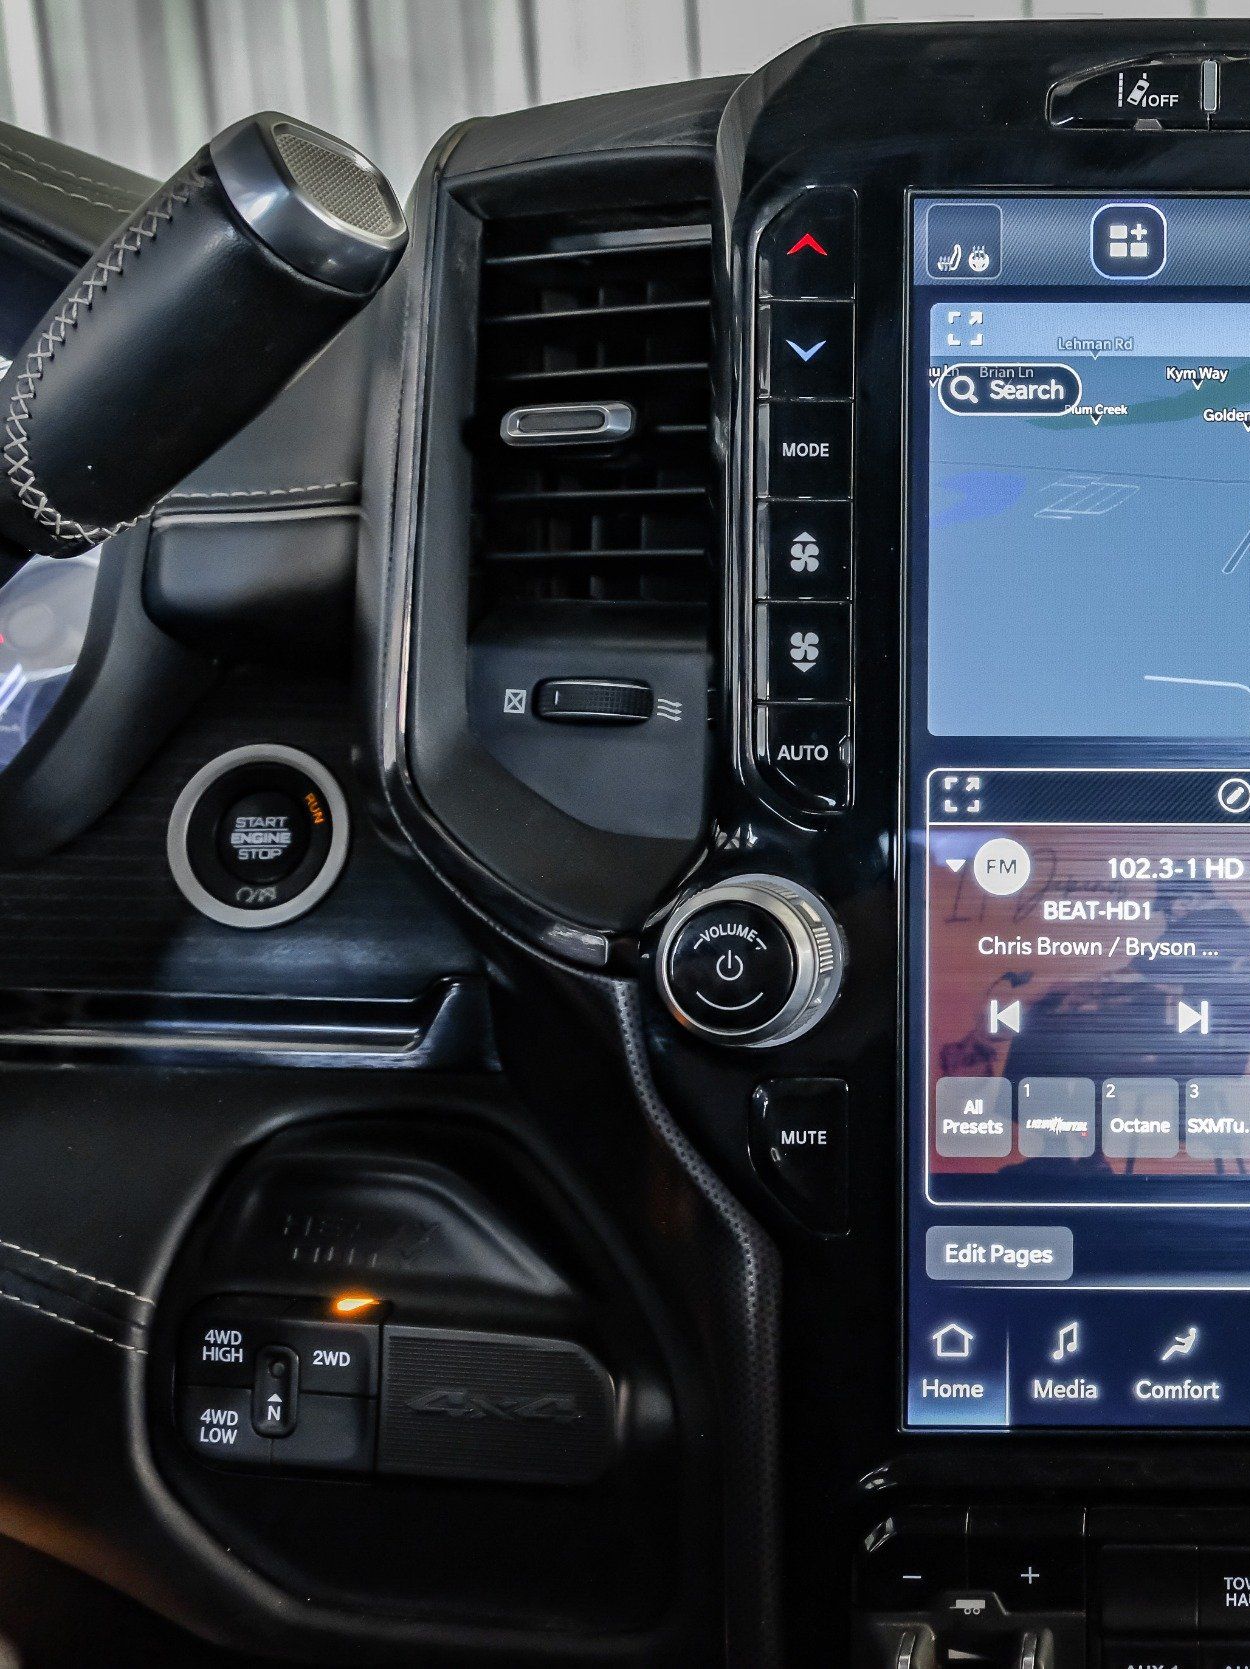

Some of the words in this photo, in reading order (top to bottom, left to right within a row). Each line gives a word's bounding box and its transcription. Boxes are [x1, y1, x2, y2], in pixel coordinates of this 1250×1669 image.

[1148, 94, 1179, 107] OFF
[1057, 336, 1111, 351] Lehman
[1114, 336, 1133, 351] Rd
[979, 367, 1015, 379] Brian
[1018, 367, 1034, 379] Ln
[1166, 366, 1197, 384] Kym
[1198, 366, 1229, 383] Way
[989, 378, 1065, 401] Search
[1094, 403, 1129, 415] Creek
[782, 442, 830, 457] MODE
[777, 744, 829, 761] AUTO
[304, 792, 325, 825] RUN
[235, 816, 288, 829] START
[230, 832, 291, 844] ENGINE
[237, 848, 283, 861] STOP
[985, 858, 1018, 875] FM
[1107, 857, 1197, 880] 102.3-1
[1205, 857, 1245, 880] HD
[1043, 899, 1151, 921] BEAT-HD1
[699, 923, 759, 943] VOLUME
[978, 935, 1033, 956] Chris
[1037, 936, 1103, 956] Brown
[1108, 936, 1121, 958] /
[1125, 936, 1198, 961] Bryson
[1023, 1083, 1030, 1098] 1
[1105, 1083, 1116, 1098] 2
[1189, 1083, 1200, 1099] 3
[963, 1098, 984, 1115] All
[942, 1118, 1004, 1135] Presets
[1109, 1117, 1171, 1134] Octane
[781, 1130, 827, 1145] MUTE
[945, 1243, 987, 1264] Edit
[990, 1243, 1054, 1268] Pages
[203, 1329, 242, 1348] 4WD
[202, 1345, 243, 1363] HIGH
[312, 1349, 351, 1367] 2WD
[922, 1378, 985, 1398] Home
[1033, 1378, 1099, 1400] Media
[1135, 1379, 1220, 1401] Comfort
[200, 1408, 239, 1426] 4WD
[267, 1405, 281, 1421] N
[199, 1426, 238, 1445] LOW
